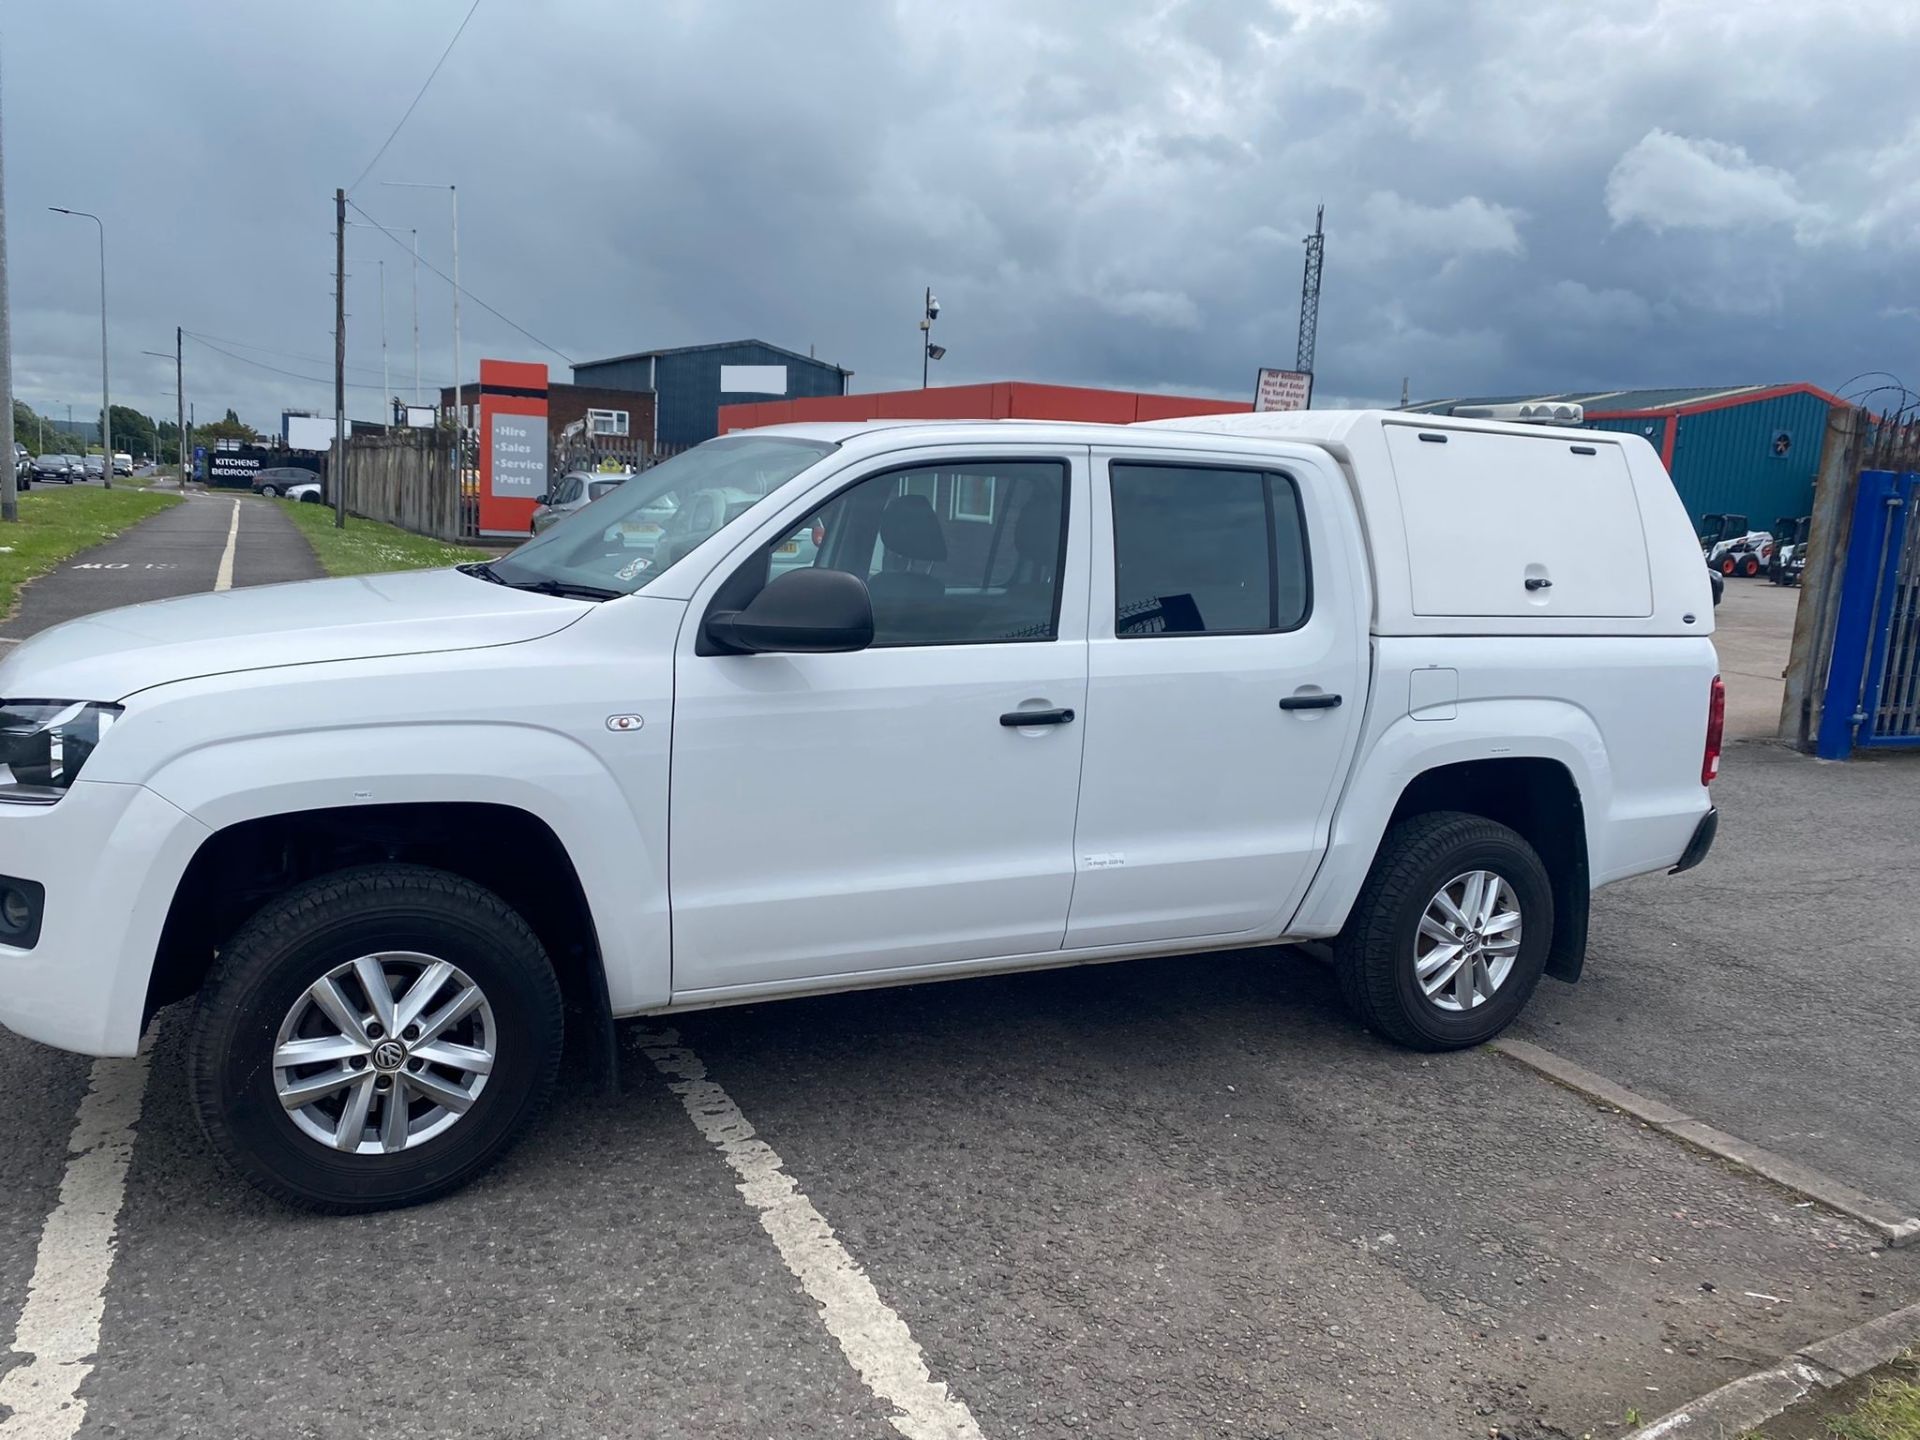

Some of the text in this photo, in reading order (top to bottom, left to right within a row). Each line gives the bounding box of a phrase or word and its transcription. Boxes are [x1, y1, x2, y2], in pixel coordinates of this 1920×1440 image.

[500, 426, 527, 437] Hire
[500, 442, 531, 453] Sales
[215, 458, 260, 467] KITCHENS
[500, 458, 544, 470] Service
[211, 467, 262, 477] BEDROOM
[500, 474, 532, 485] Parts
